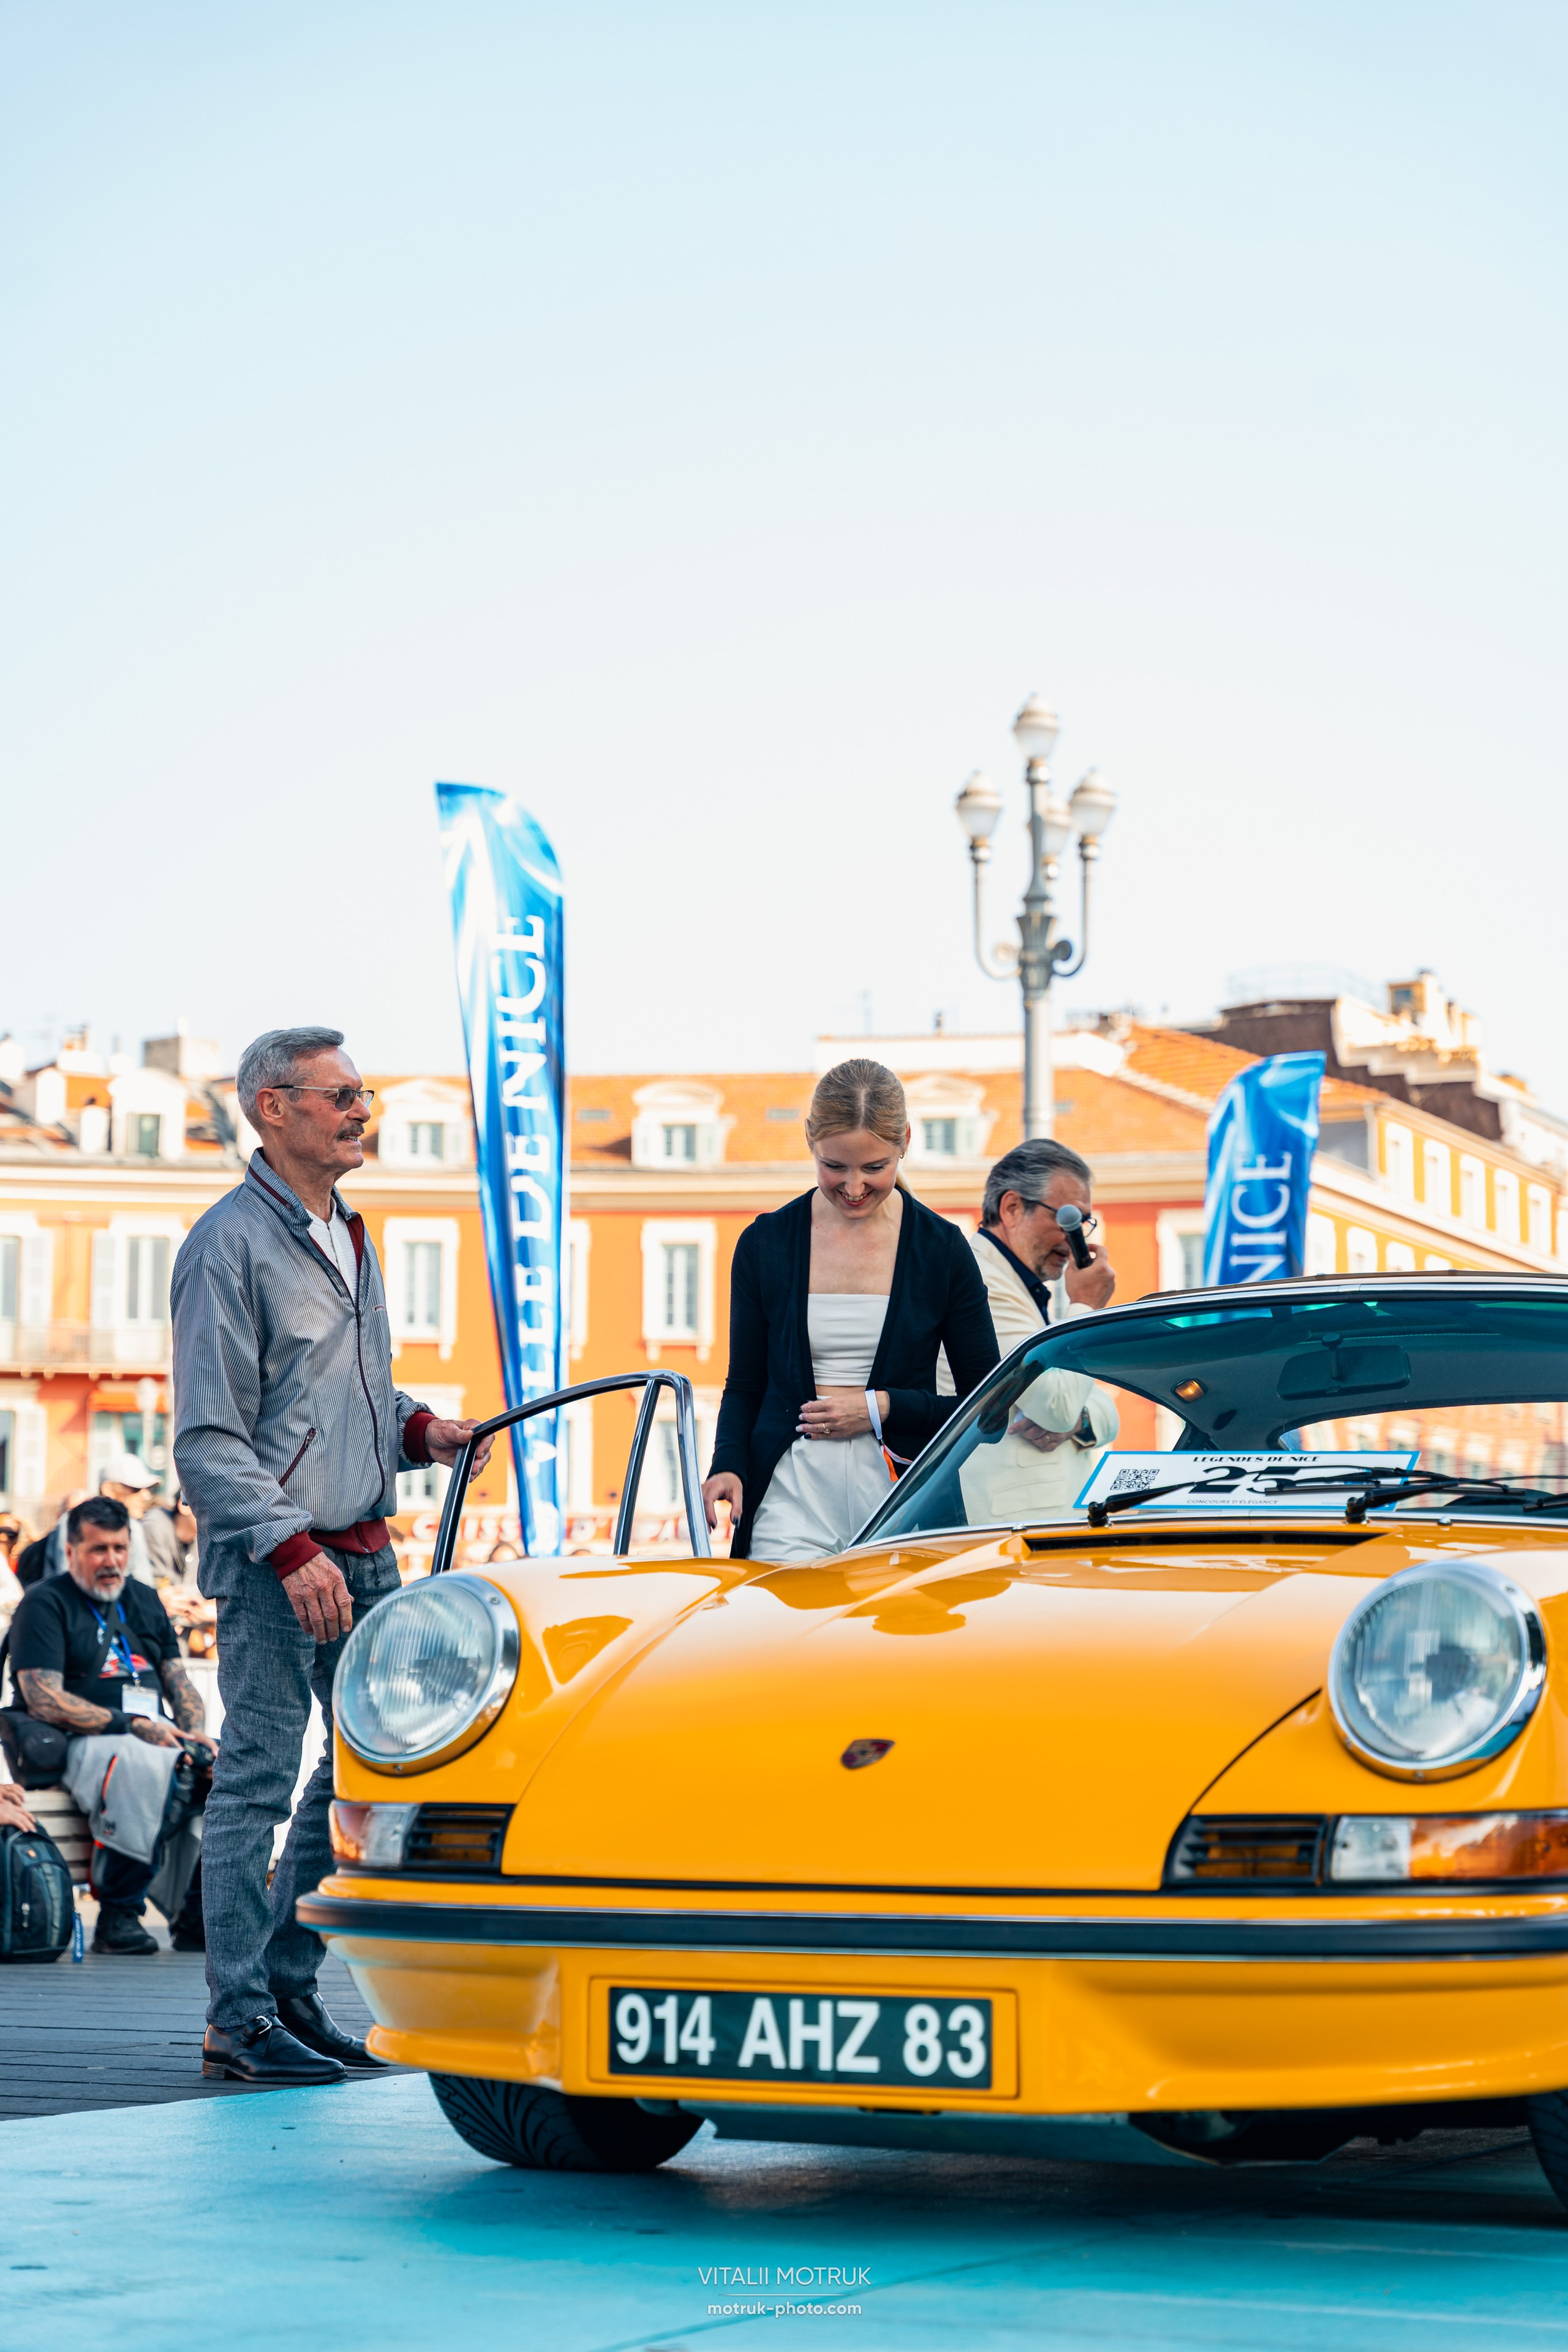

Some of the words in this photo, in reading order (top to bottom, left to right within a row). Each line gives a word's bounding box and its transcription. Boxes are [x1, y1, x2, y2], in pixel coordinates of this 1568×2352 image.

[491, 914, 549, 1114] NICE
[505, 1133, 552, 1245] DE
[1229, 1151, 1292, 1284] NICE
[1188, 1466, 1302, 1494] 25
[616, 1993, 716, 2066] 914
[738, 1997, 880, 2074] AHZ
[903, 2003, 986, 2079] 83
